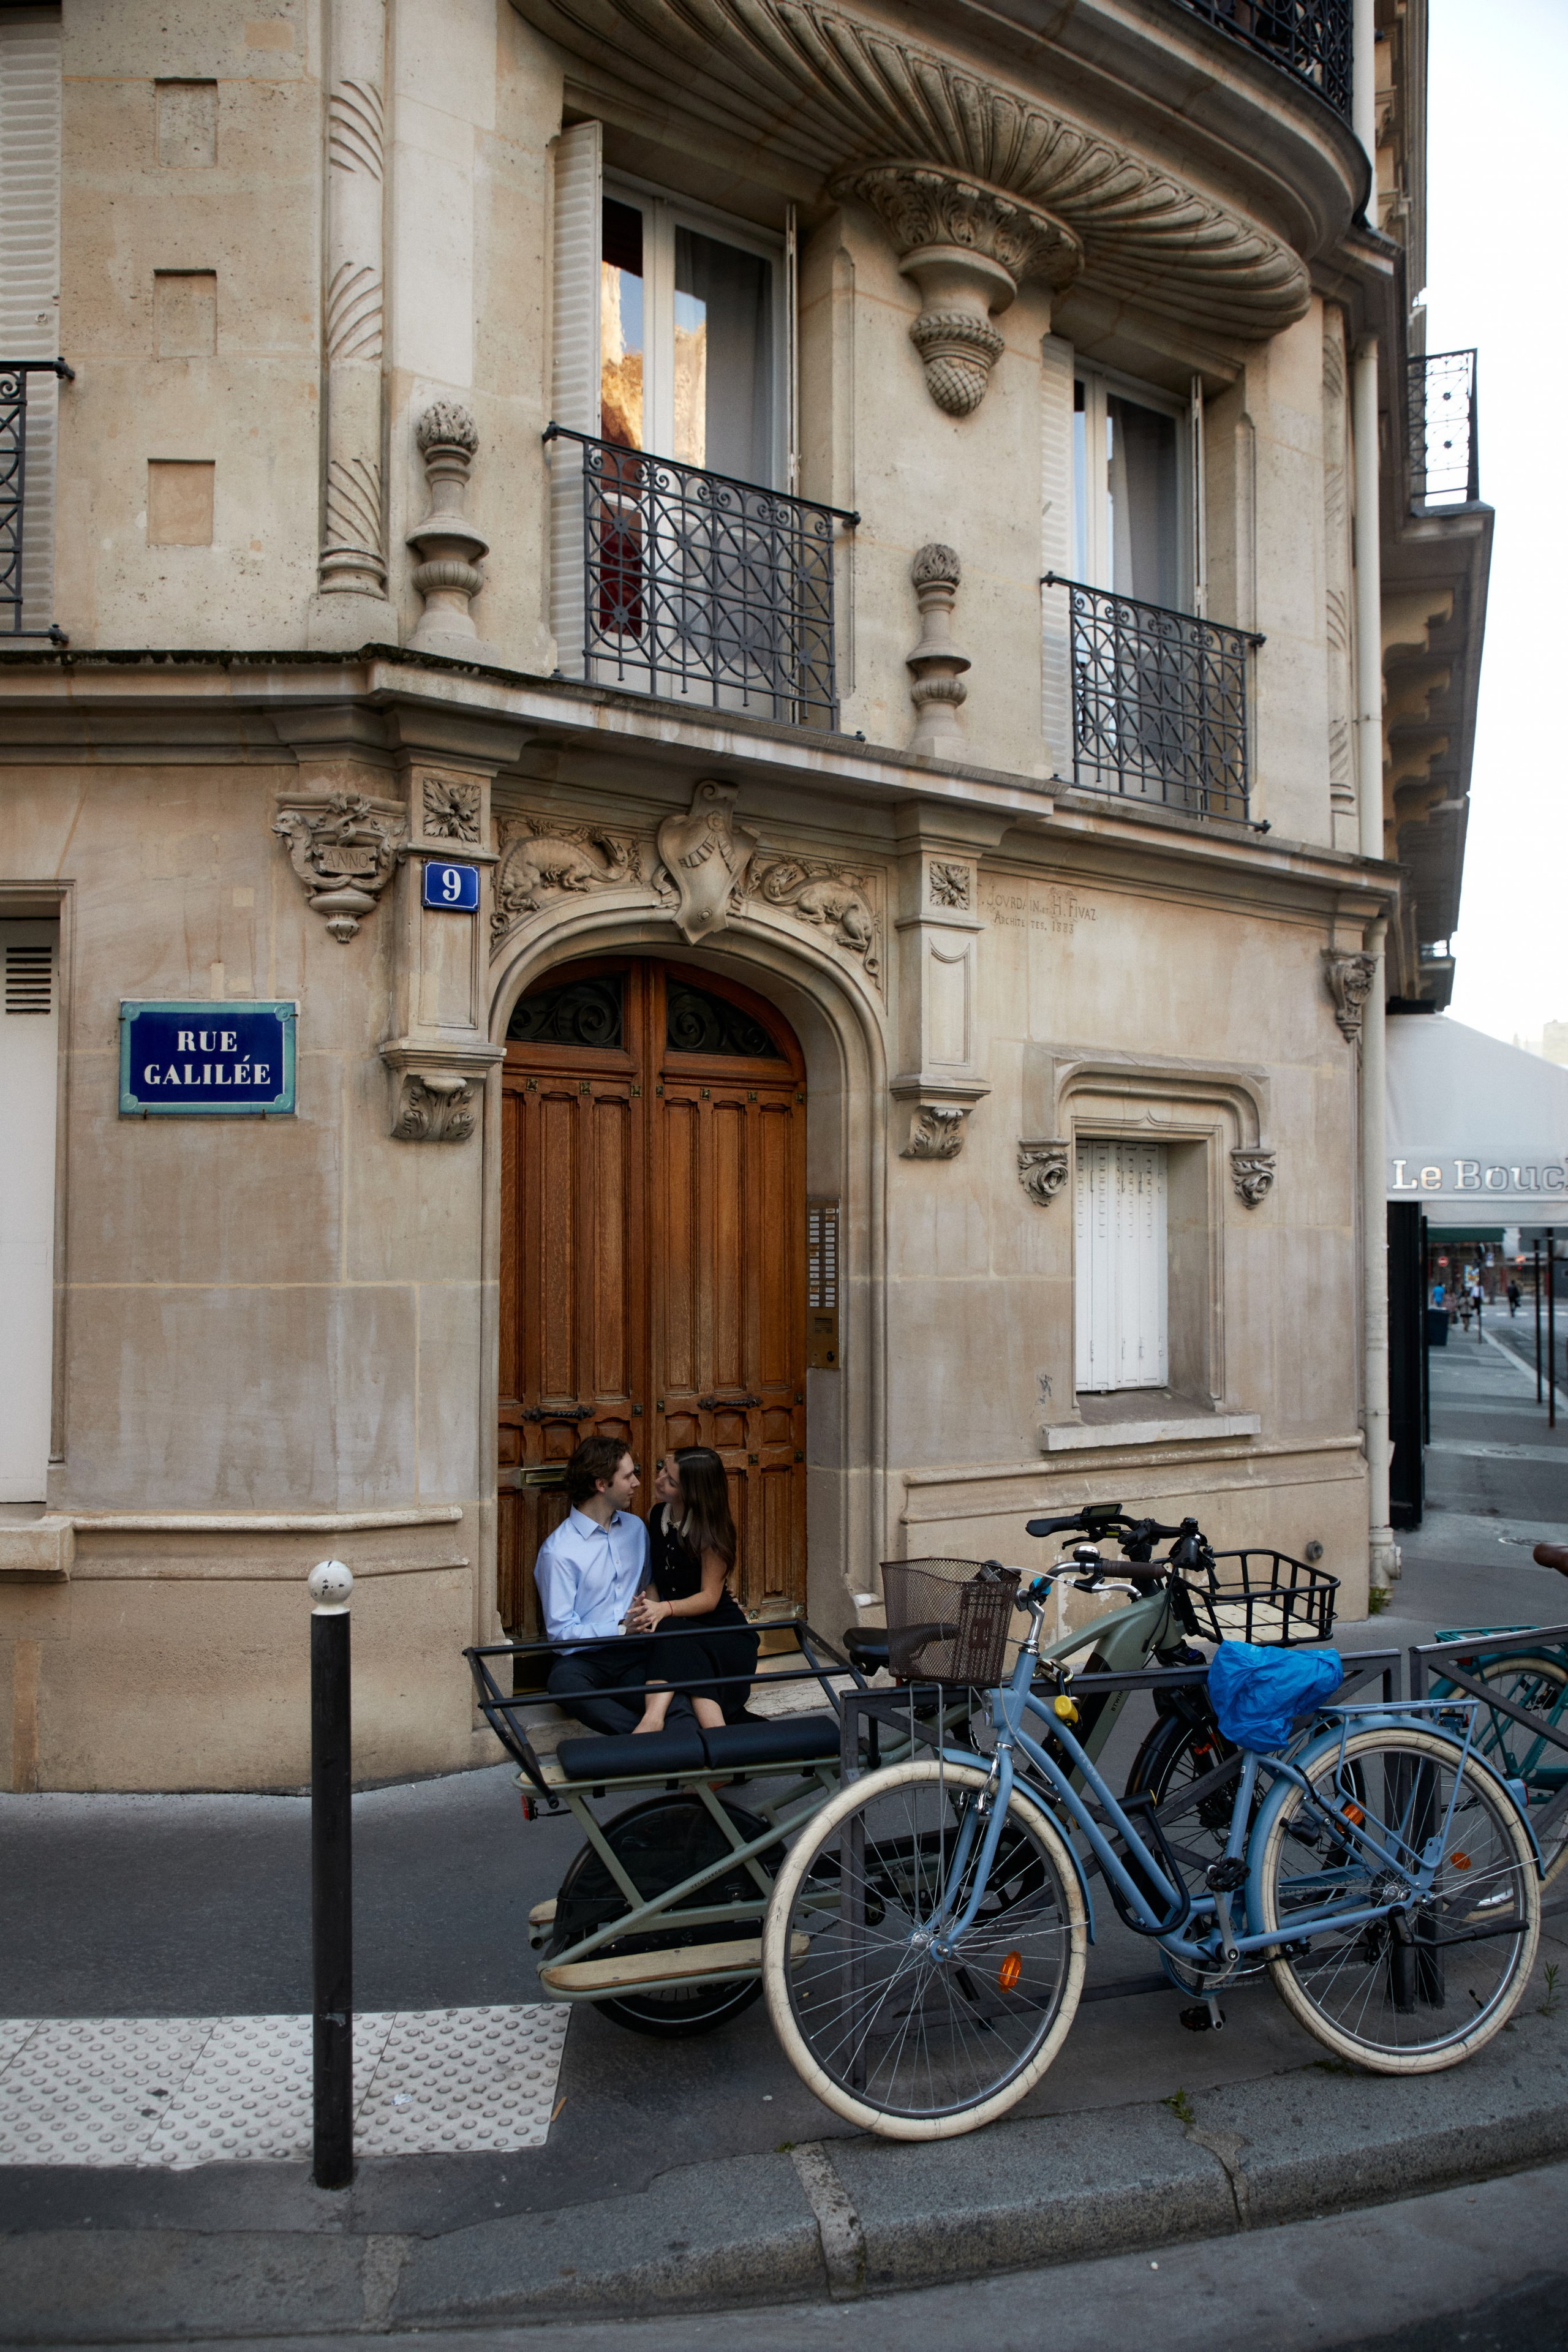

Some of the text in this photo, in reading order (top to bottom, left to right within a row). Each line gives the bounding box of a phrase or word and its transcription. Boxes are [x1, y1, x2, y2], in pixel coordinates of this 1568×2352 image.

[323, 851, 368, 869] ANNO
[442, 869, 461, 901] 9
[177, 1031, 238, 1052] RUE
[143, 1054, 271, 1085] GALILÉE
[1391, 1157, 1568, 1191] Le Bouc
[1079, 1752, 1100, 1782] ELOPS
